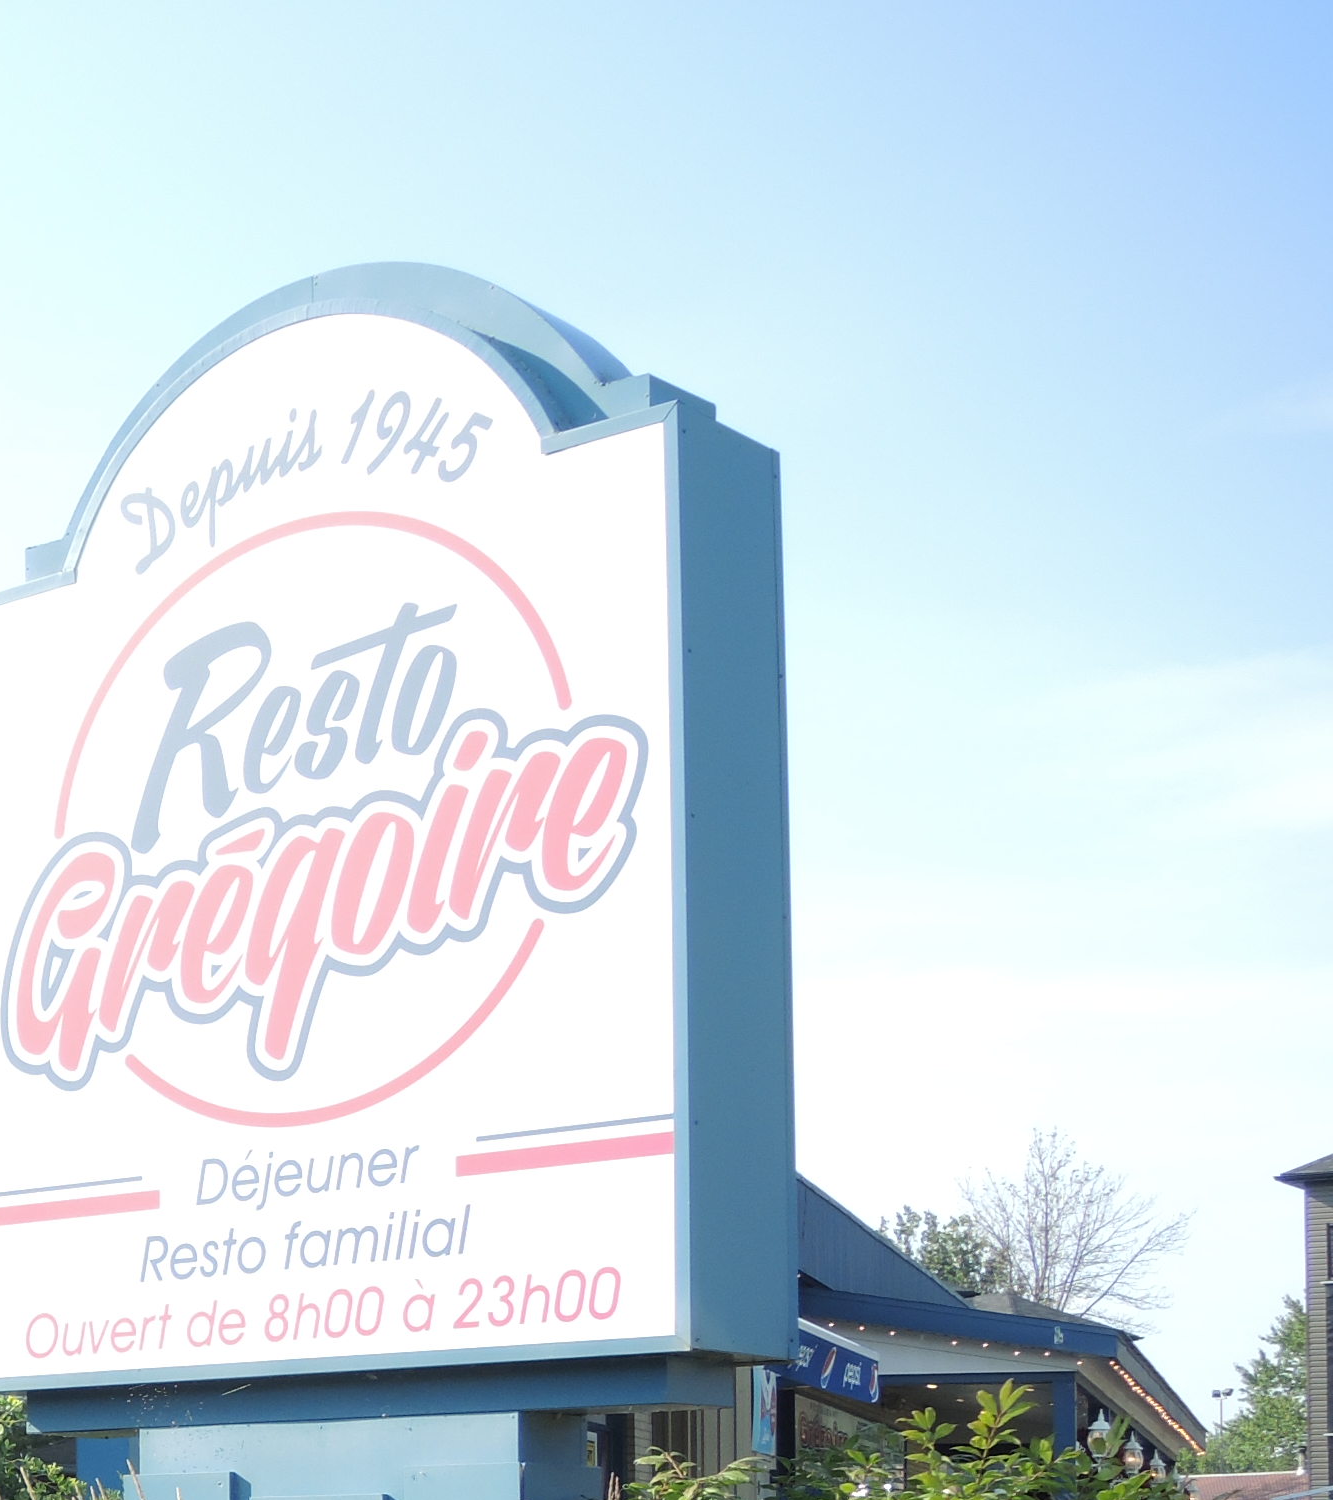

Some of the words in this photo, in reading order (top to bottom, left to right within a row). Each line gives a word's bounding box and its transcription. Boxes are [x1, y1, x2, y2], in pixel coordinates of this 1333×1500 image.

[120, 408, 322, 575] Depuis
[340, 389, 493, 482] 1945
[131, 602, 458, 854] Resto
[13, 727, 630, 1074] Grégoire
[140, 1227, 266, 1283] Resto
[283, 1205, 472, 1269] familial
[196, 1143, 420, 1210] Déjeuner
[25, 1305, 171, 1360] Ouvert
[186, 1292, 246, 1348] de
[263, 1285, 383, 1344] 8h00
[402, 1278, 435, 1332] à
[453, 1265, 622, 1330] 23h00
